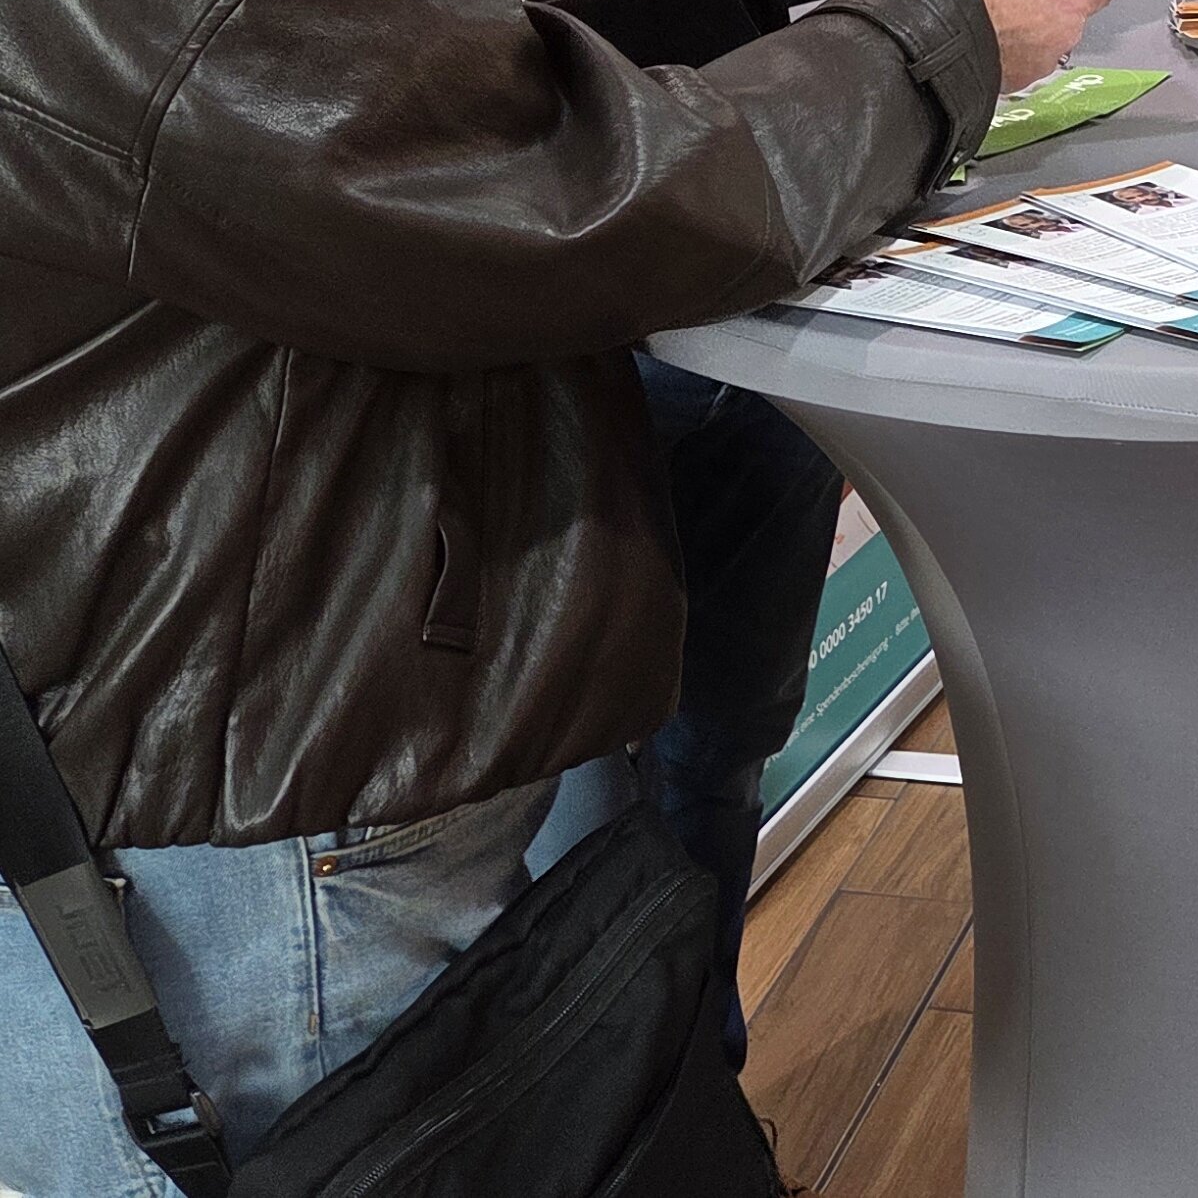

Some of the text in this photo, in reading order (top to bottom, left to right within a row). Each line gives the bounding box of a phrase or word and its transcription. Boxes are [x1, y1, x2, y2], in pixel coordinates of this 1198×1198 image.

[819, 621, 847, 660] 0000
[846, 596, 874, 633] 3450
[875, 580, 889, 605] 17
